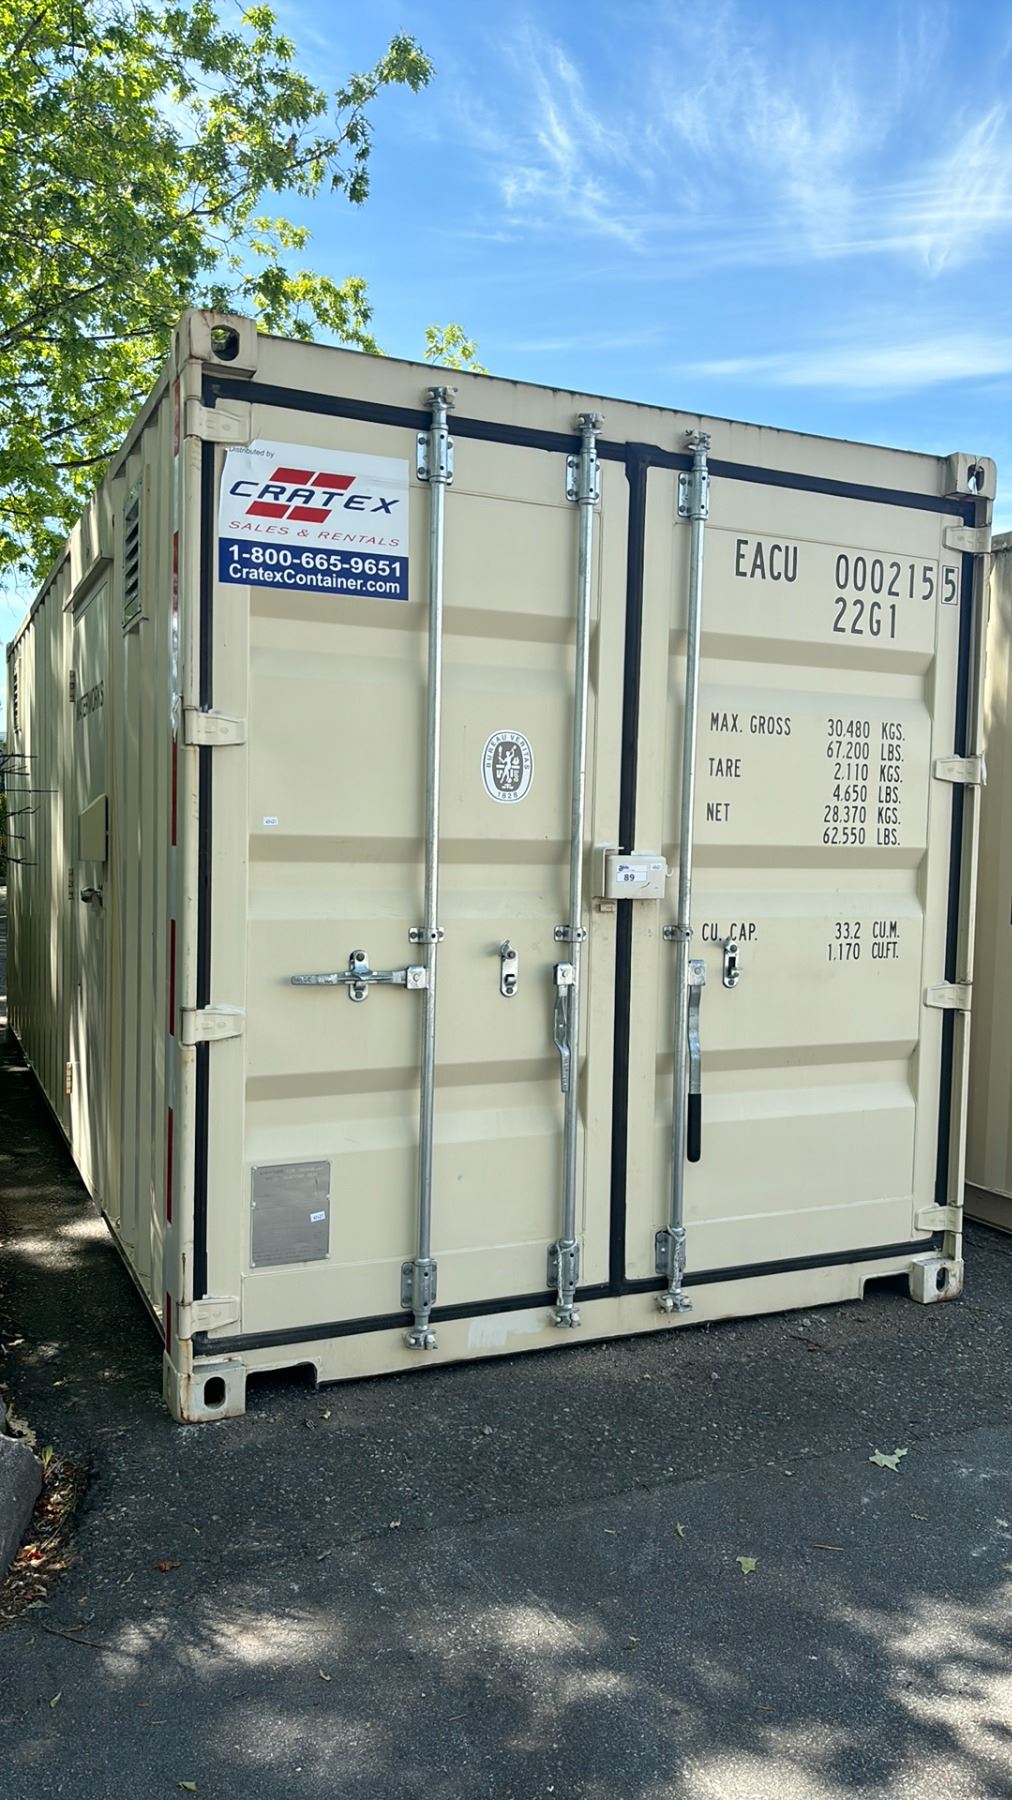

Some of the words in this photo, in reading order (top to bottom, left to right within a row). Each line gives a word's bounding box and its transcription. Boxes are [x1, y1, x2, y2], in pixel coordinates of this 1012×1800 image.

[265, 450, 275, 459] by
[229, 480, 400, 514] CRATEX
[228, 520, 290, 535] SALES
[297, 528, 309, 538] &
[316, 531, 401, 547] RENTALS
[228, 544, 401, 577] 1-800-665-9651
[735, 538, 798, 583] EACU
[229, 563, 401, 594] CratexContainer.com
[833, 596, 896, 639] 22G1
[710, 712, 743, 734] MAX.
[750, 715, 791, 736] GROSS
[881, 722, 905, 741] KGS.
[486, 735, 507, 768] BUREAU
[510, 734, 530, 769] VERITAS
[880, 743, 904, 762] LBS.
[709, 757, 742, 778] TARE
[879, 764, 903, 783] KGS.
[878, 785, 901, 804] LBS.
[706, 802, 730, 822] NET
[877, 806, 901, 825] KGS.
[876, 828, 900, 846] LBS.
[623, 873, 635, 882] 89
[701, 922, 722, 942] CU.
[729, 922, 758, 942] CAP.
[834, 921, 861, 940] 33.2
